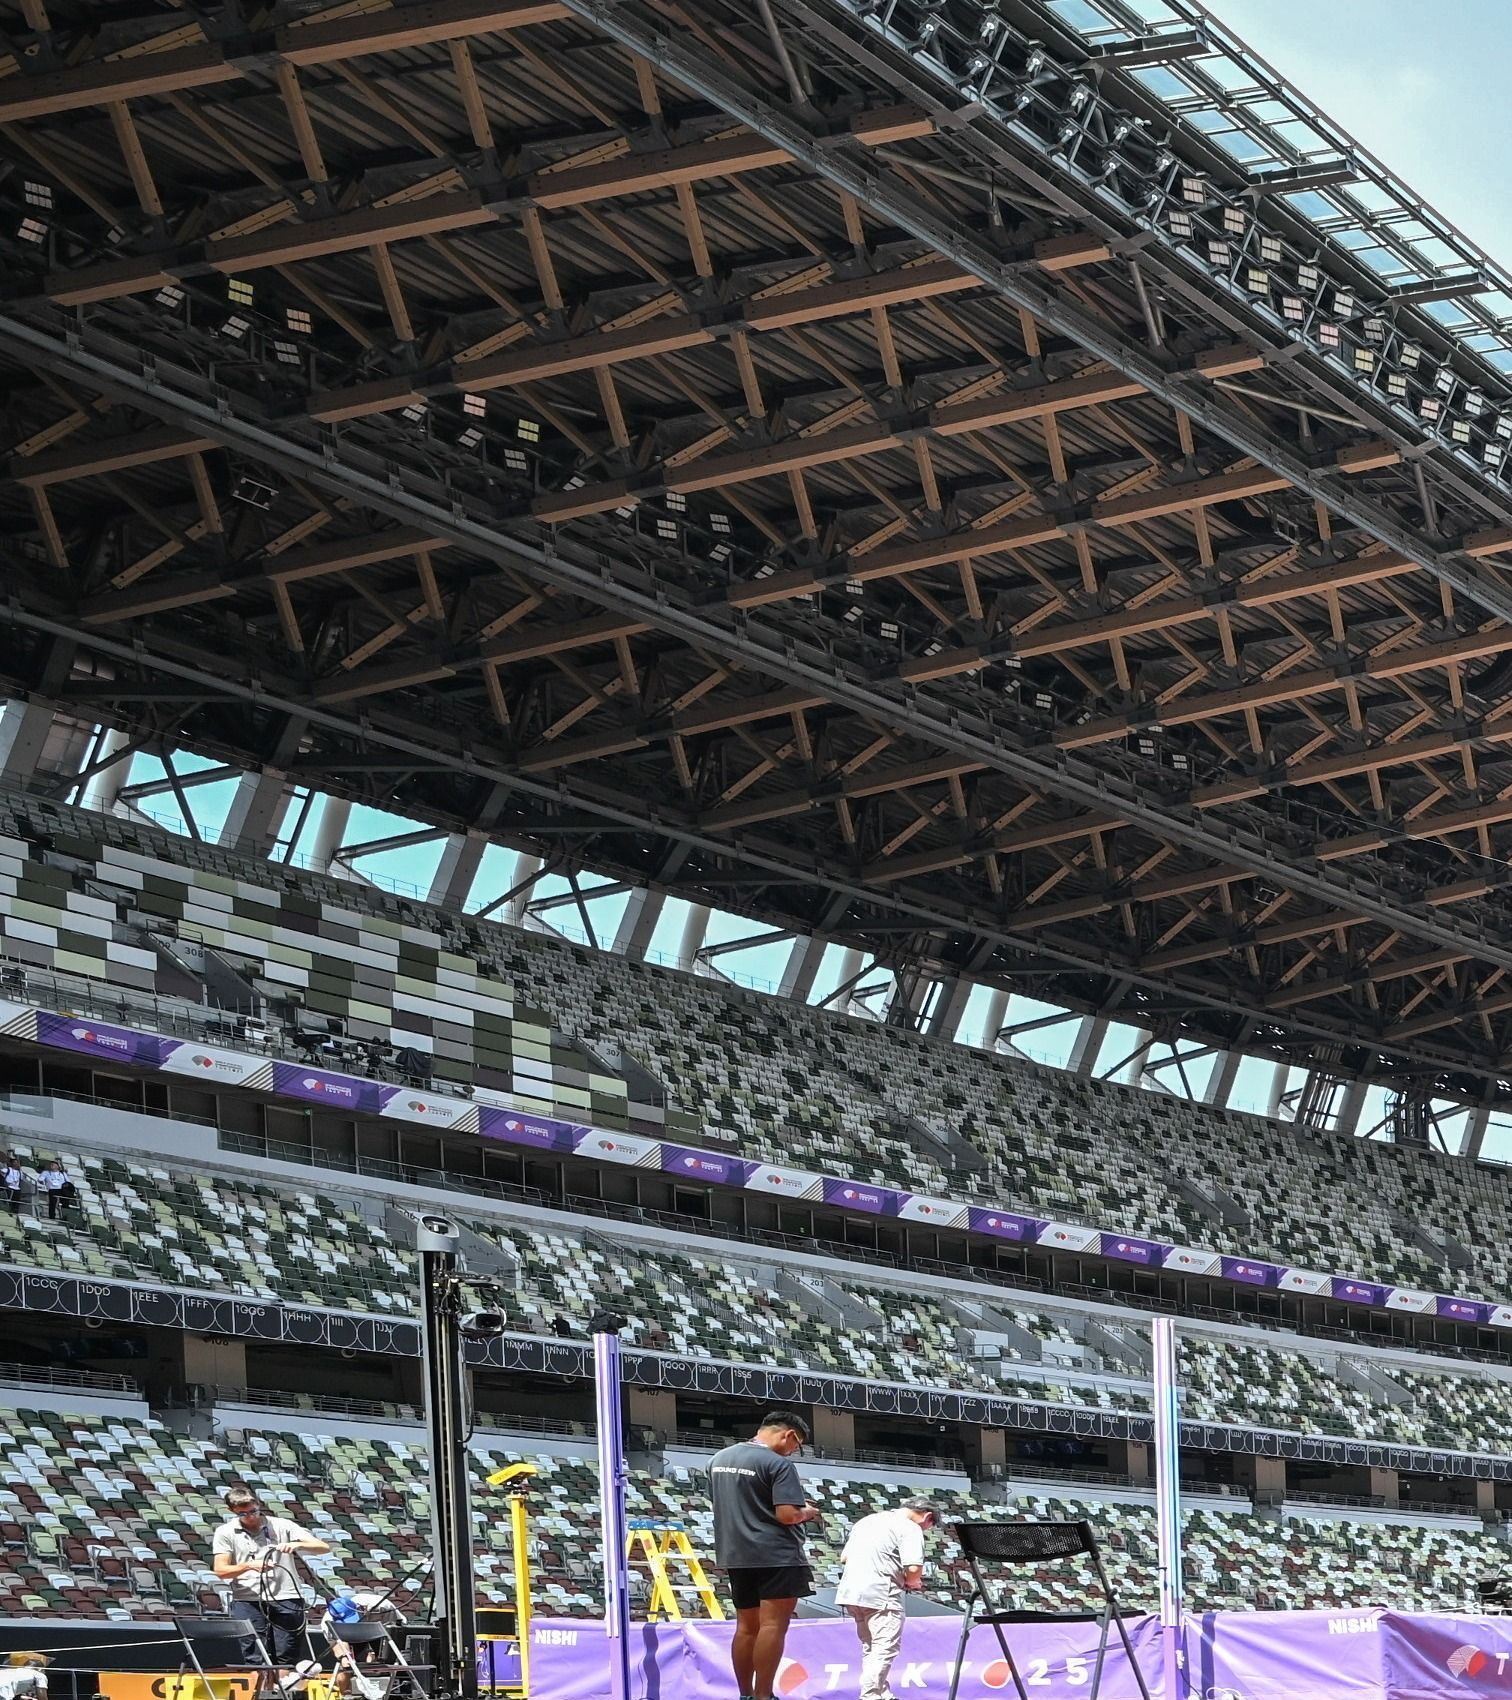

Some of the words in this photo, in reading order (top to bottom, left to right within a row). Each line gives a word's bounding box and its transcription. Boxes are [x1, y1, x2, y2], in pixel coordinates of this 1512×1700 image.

[184, 946, 204, 958] 308
[606, 1048, 620, 1058] 307
[27, 1277, 58, 1290] 1CCC
[81, 1284, 111, 1297] 1DDD
[134, 1291, 159, 1303] 1EEE
[186, 1298, 209, 1310] 1FFF
[236, 1304, 265, 1317] 1GGG
[284, 1311, 311, 1323] 1HHH
[506, 1340, 533, 1352] 1MMM
[546, 1346, 569, 1356] 1NNN
[624, 1354, 643, 1365] 1PPP
[699, 1365, 718, 1375] 1RRR
[1328, 1617, 1379, 1635] NISHI
[535, 1629, 578, 1646] NISHI
